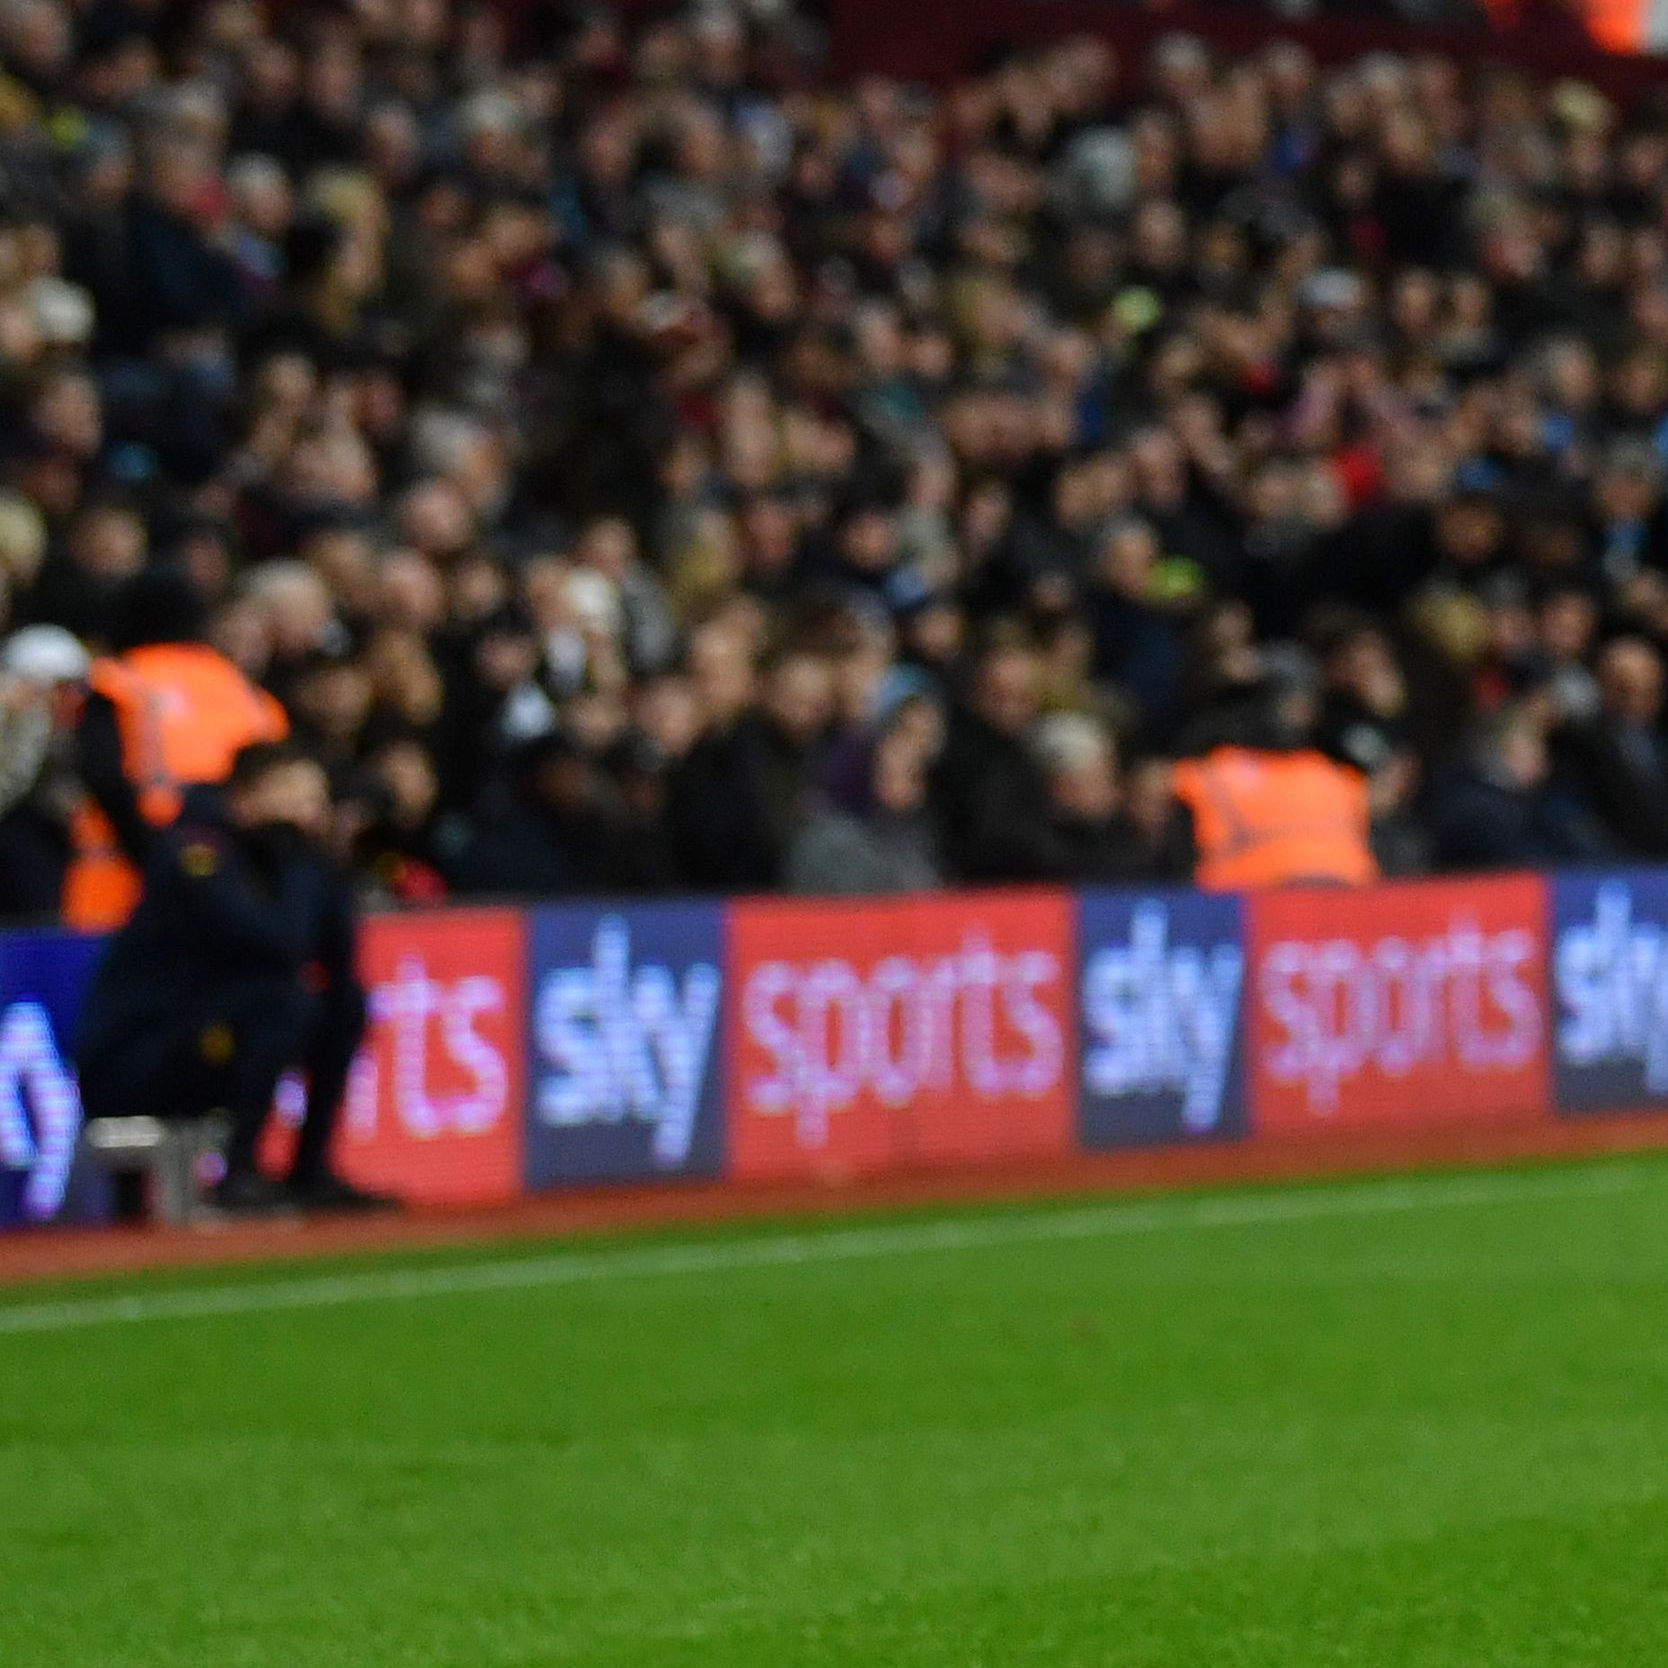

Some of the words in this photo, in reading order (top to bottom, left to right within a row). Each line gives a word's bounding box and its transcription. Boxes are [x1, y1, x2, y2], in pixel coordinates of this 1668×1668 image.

[536, 914, 721, 1165] sky
[743, 924, 1063, 1148] sports
[1082, 897, 1246, 1133] sky
[1260, 910, 1543, 1115] sports
